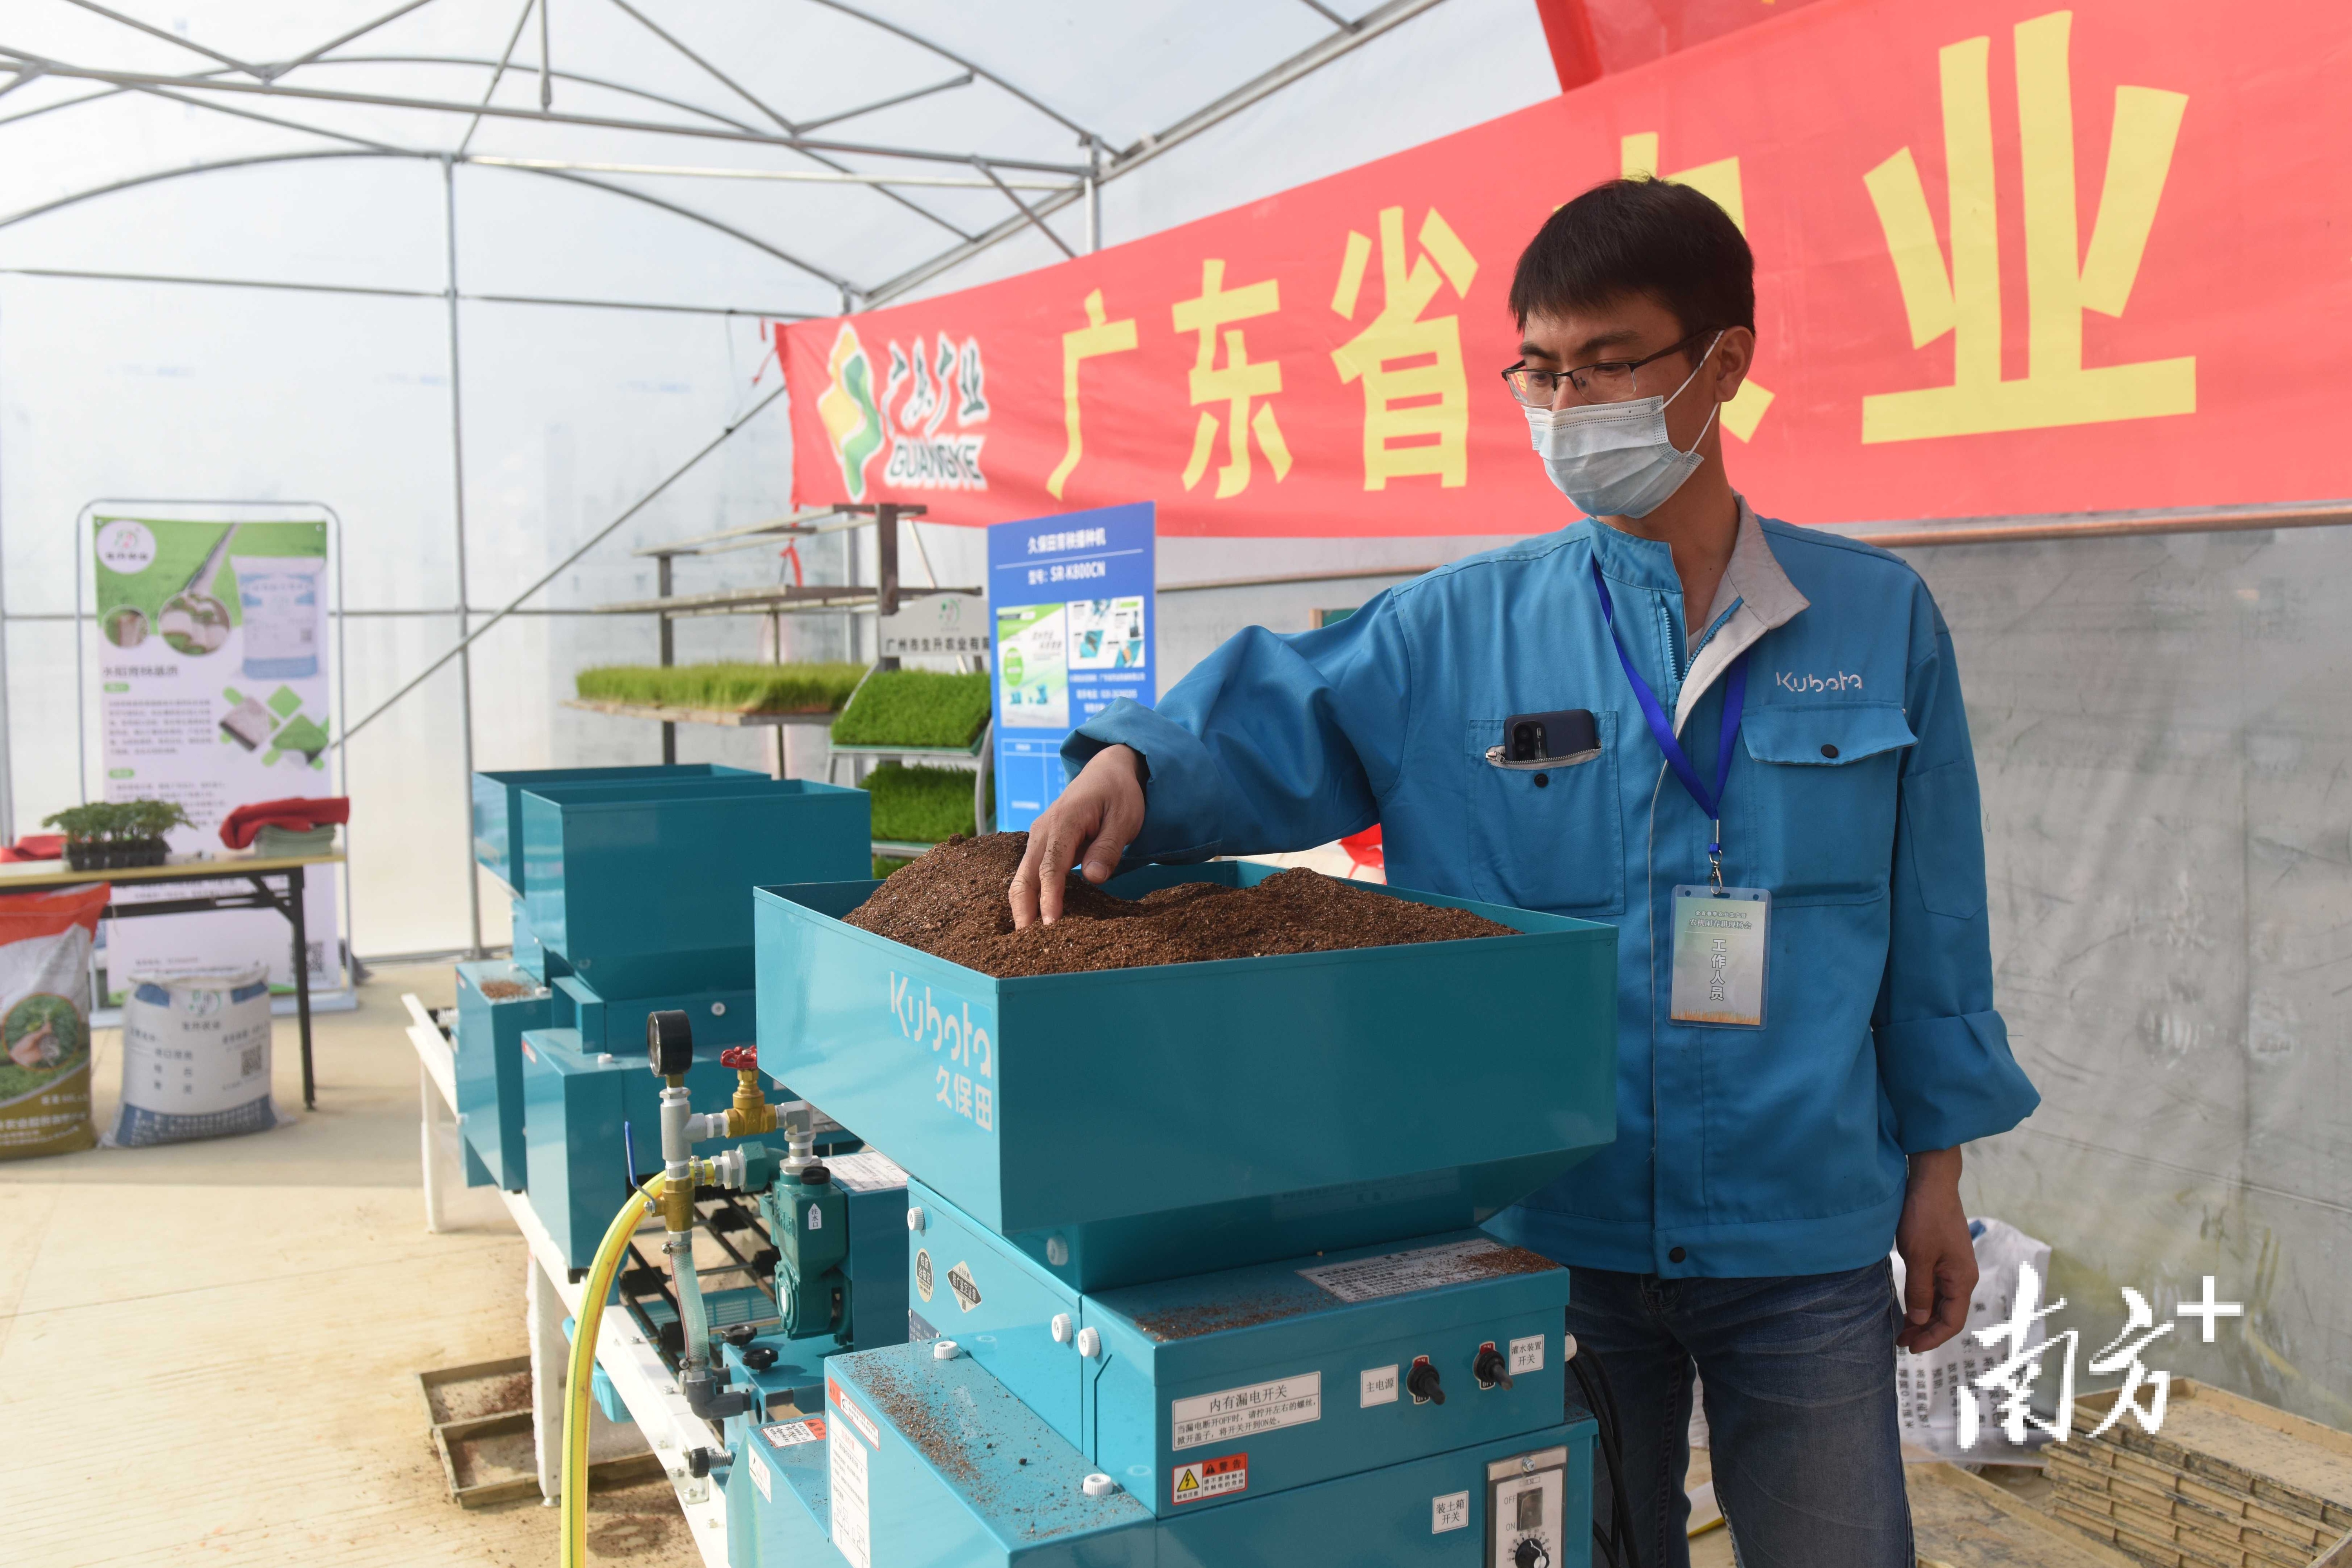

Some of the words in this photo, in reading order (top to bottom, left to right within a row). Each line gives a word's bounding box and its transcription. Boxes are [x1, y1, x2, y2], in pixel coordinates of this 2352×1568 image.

[1775, 671, 1863, 692] Kubota
[1695, 910, 1747, 919] 全省春季农业生产暨
[1690, 918, 1752, 930] 农机闹春耕现场会
[1710, 939, 1726, 1001] 工作人员
[890, 971, 992, 1079] Kubota
[936, 1065, 993, 1132] 久保田
[918, 1266, 931, 1284] 合格证
[952, 1272, 976, 1302] 推广鉴定证章
[1512, 1341, 1542, 1355] 灌水装置
[1518, 1353, 1535, 1367] 开关
[1365, 1377, 1394, 1393] 主电源
[1210, 1385, 1287, 1413] 内有漏电开关
[1176, 1491, 1199, 1500] 触电注意
[1504, 1495, 1517, 1505] OFF
[1436, 1499, 1465, 1514] 装土箱
[1442, 1512, 1460, 1525] 开关
[1506, 1523, 1515, 1531] ON
